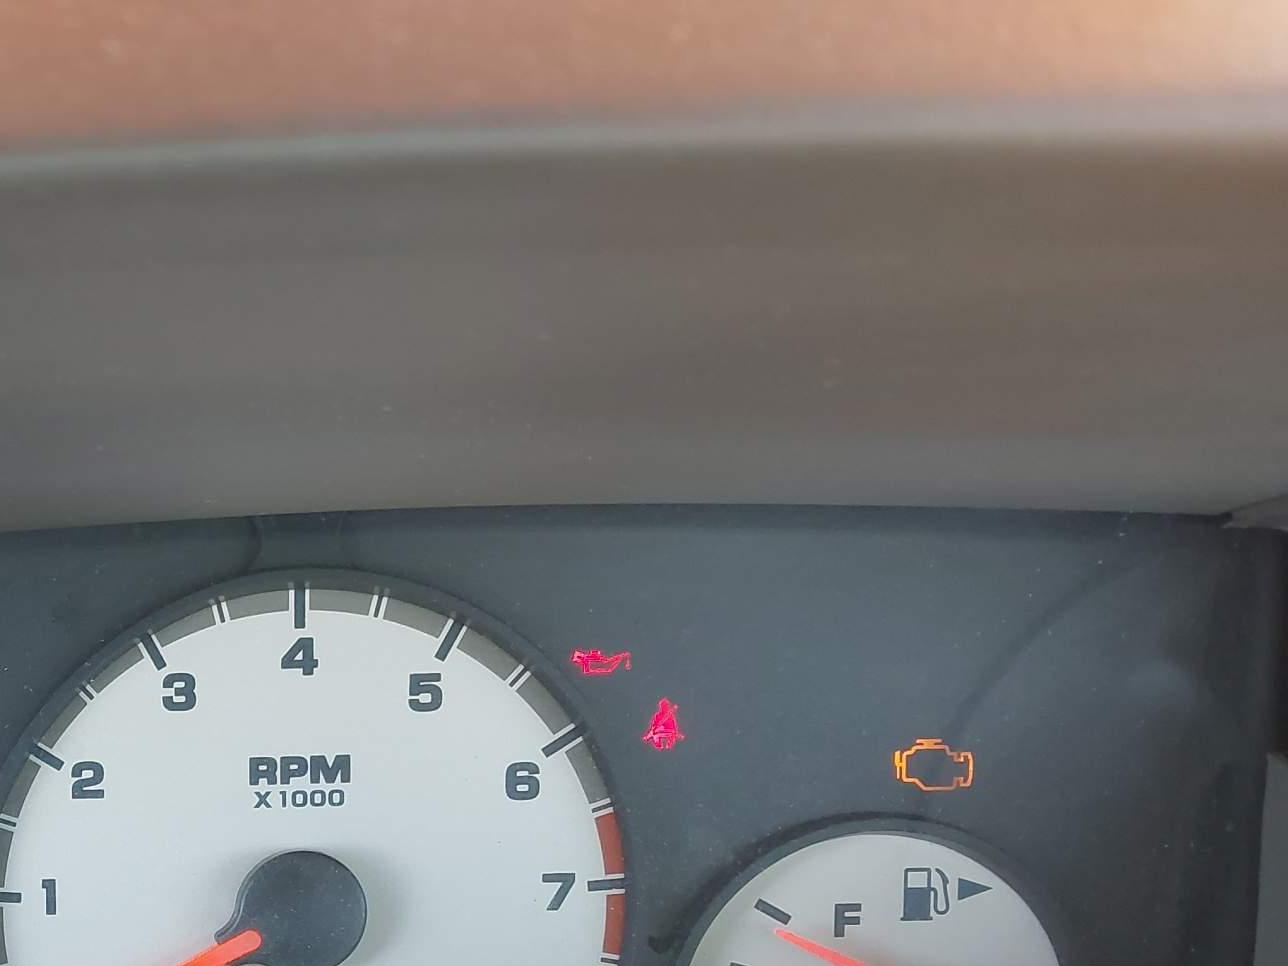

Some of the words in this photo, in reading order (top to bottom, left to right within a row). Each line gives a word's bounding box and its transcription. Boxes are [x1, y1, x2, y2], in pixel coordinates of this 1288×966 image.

[281, 637, 318, 675] 4
[162, 673, 197, 712] 3
[408, 673, 443, 711] 5
[71, 761, 105, 799] 2
[249, 755, 352, 785] RPM
[505, 761, 540, 800] 6
[40, 878, 57, 915] 1
[541, 873, 576, 911] 7
[834, 903, 861, 937] F
